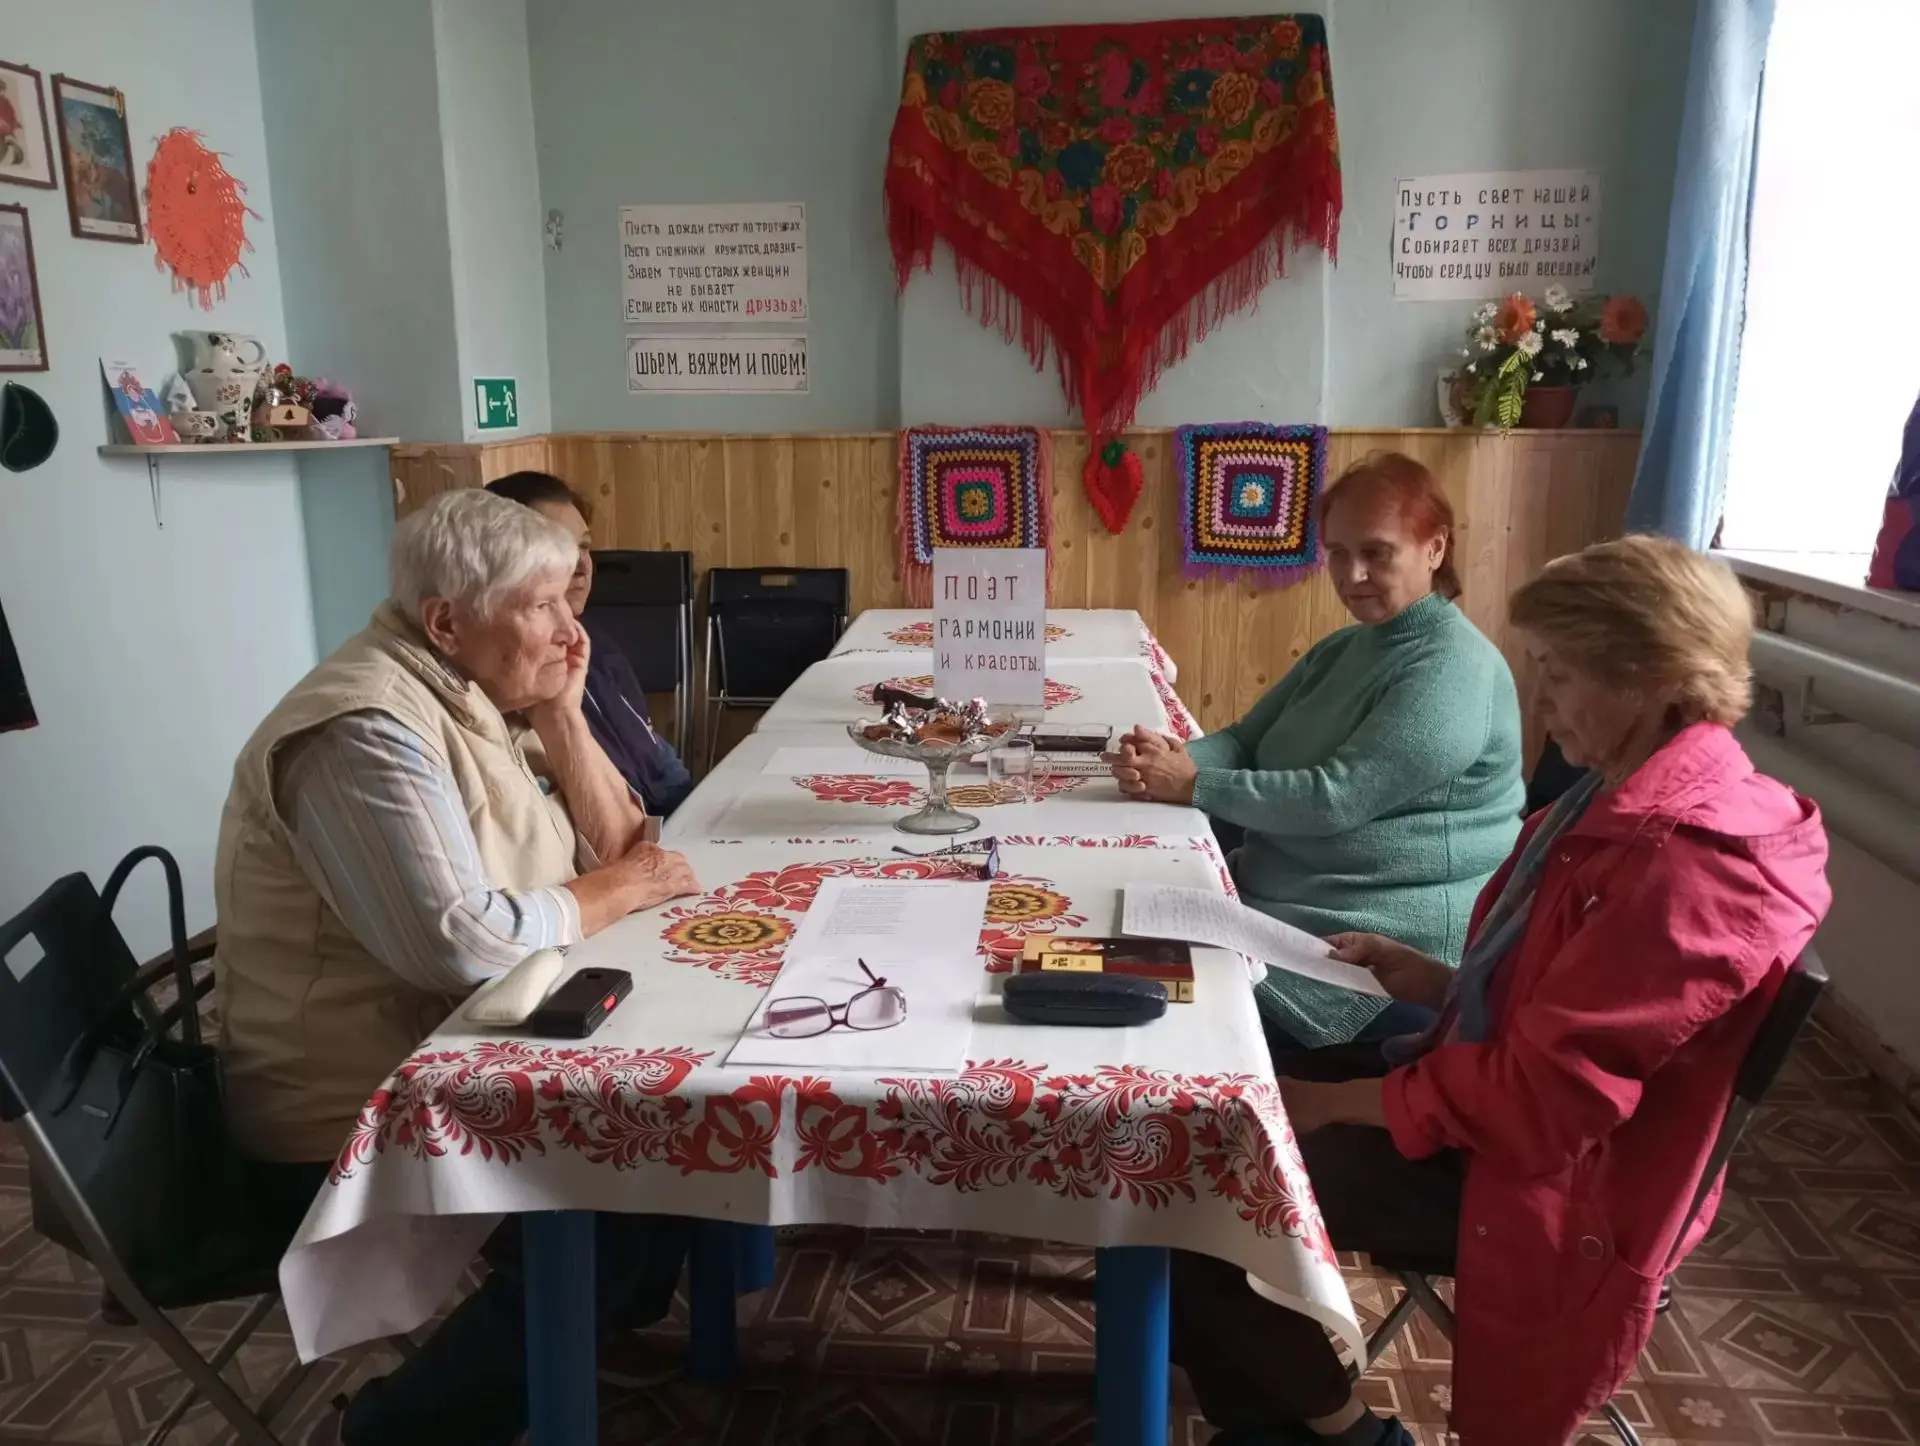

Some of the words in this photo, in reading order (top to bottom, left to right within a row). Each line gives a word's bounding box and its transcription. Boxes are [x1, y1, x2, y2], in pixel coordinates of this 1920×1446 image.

[1401, 189, 1461, 207] Пусть
[1479, 188, 1524, 205] свет
[1534, 185, 1590, 204] нашей
[668, 223, 704, 236] дожди
[1401, 237, 1479, 254] Собирает
[1488, 238, 1517, 253] всех
[1523, 234, 1580, 254] друзей
[742, 264, 790, 279] женщин
[1440, 262, 1491, 280] сердцу
[1499, 262, 1529, 278] было
[690, 283, 735, 296] бывает
[628, 299, 653, 314] Если
[655, 300, 678, 314] есть
[944, 575, 1019, 601] ПОЭТ
